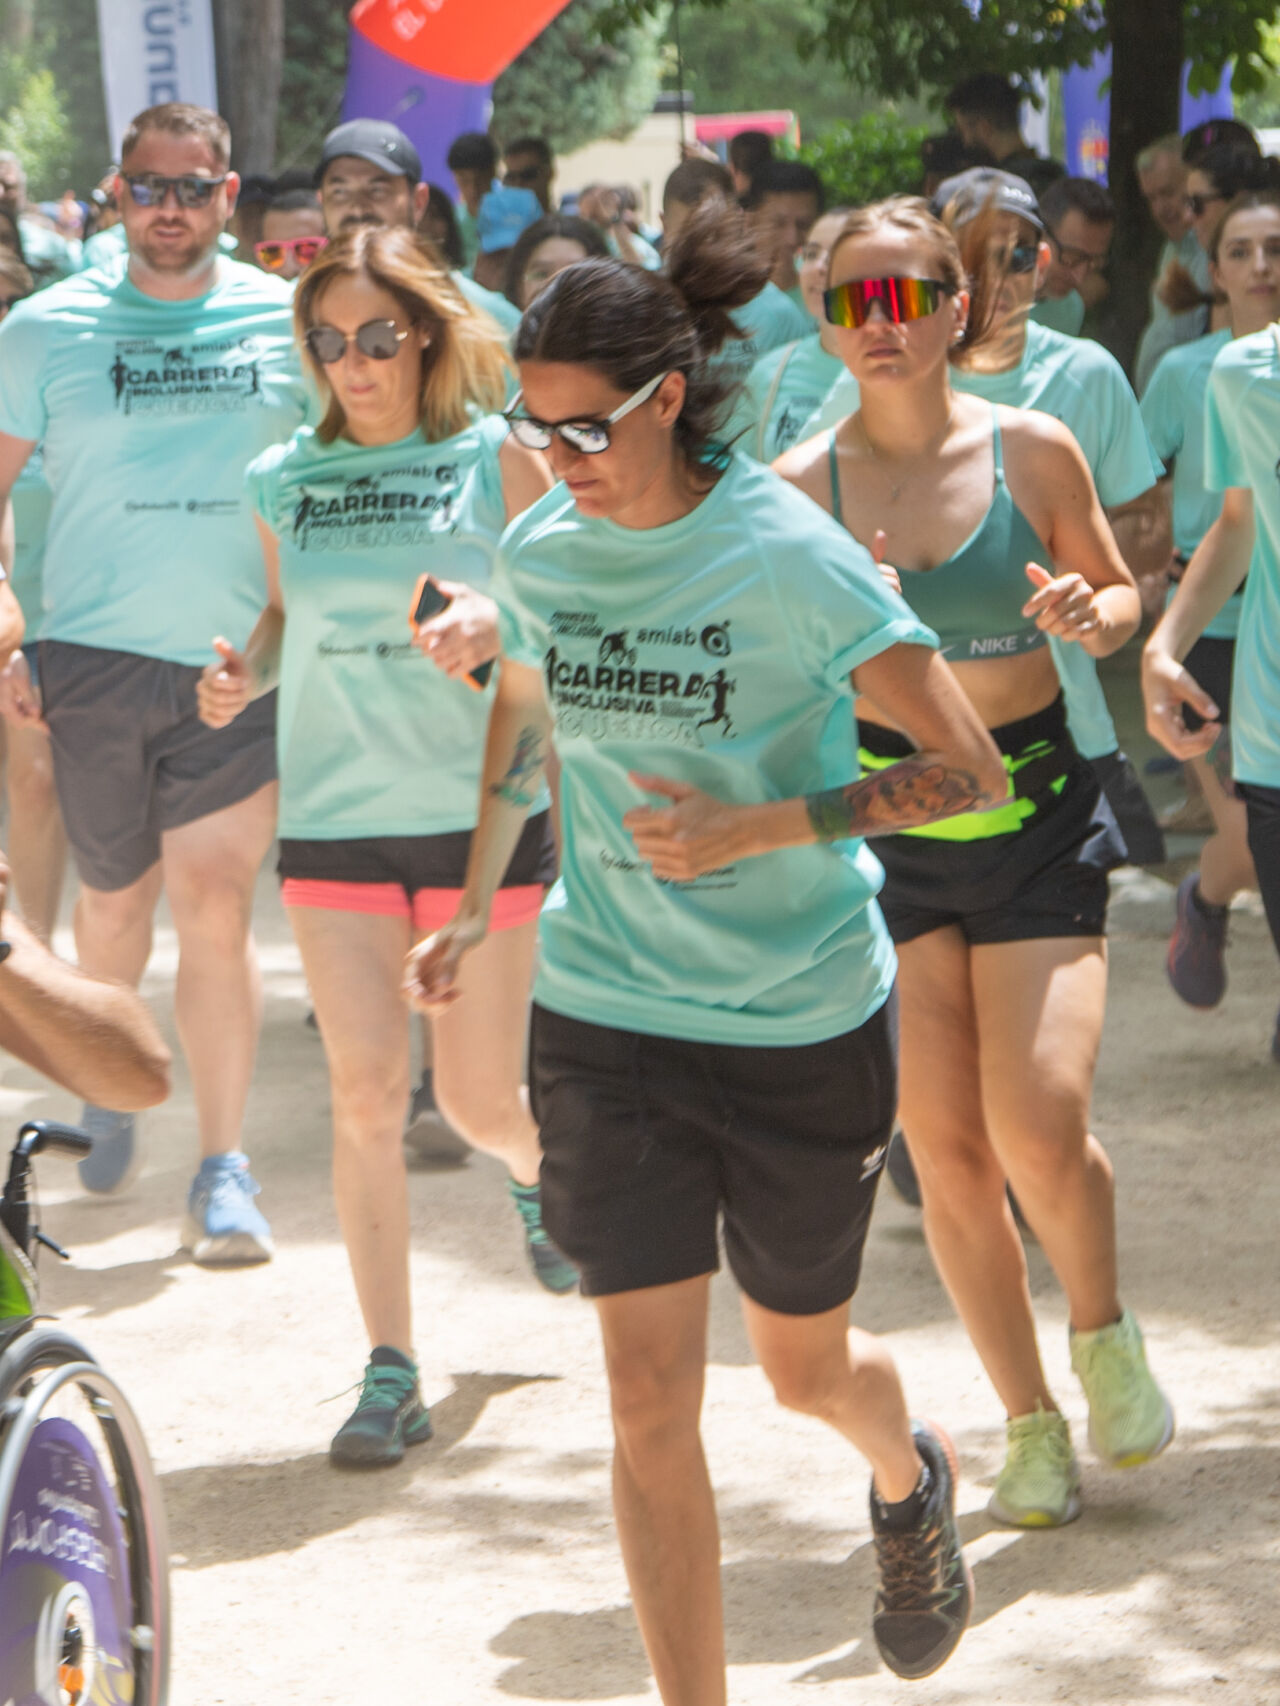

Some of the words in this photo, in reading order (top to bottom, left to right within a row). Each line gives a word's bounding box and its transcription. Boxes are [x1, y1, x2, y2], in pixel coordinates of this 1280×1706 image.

[127, 365, 246, 385] CARRERA
[310, 493, 439, 518] CARRERA
[310, 512, 396, 529] INCLUSIVA
[970, 635, 1017, 656] NIKE
[556, 661, 711, 699] CARRERA
[556, 690, 656, 714] INCLUSIVA
